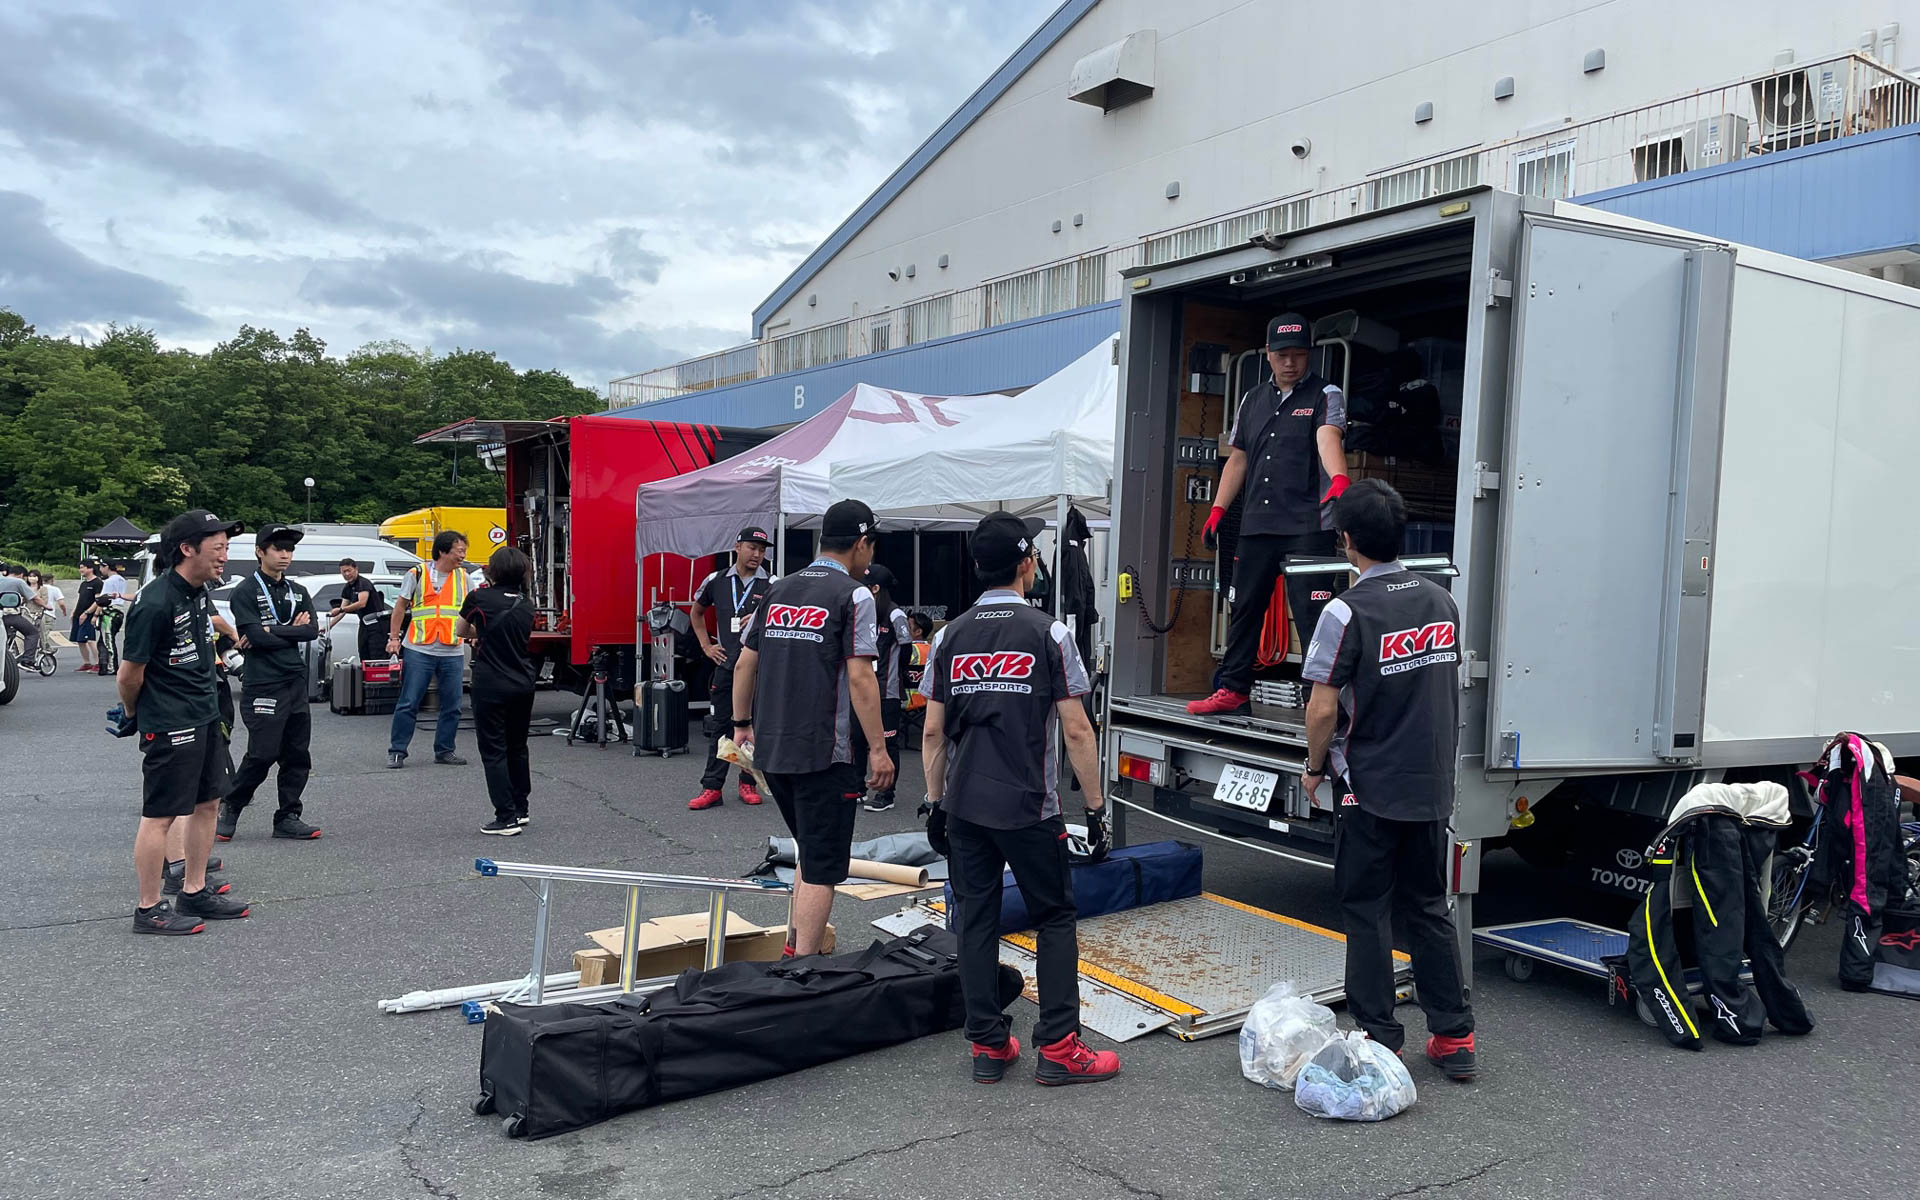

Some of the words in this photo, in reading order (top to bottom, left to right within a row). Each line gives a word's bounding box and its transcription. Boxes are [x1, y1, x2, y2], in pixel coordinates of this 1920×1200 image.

[794, 384, 805, 410] B
[765, 603, 830, 630] KYB
[1379, 620, 1456, 663] KYB
[950, 650, 1036, 682] KYB
[1380, 652, 1458, 676] MOTORSPORTS
[951, 681, 1033, 696] MOTRSPORTS
[1226, 780, 1270, 807] 76-85
[1591, 867, 1650, 893] TOYOT
